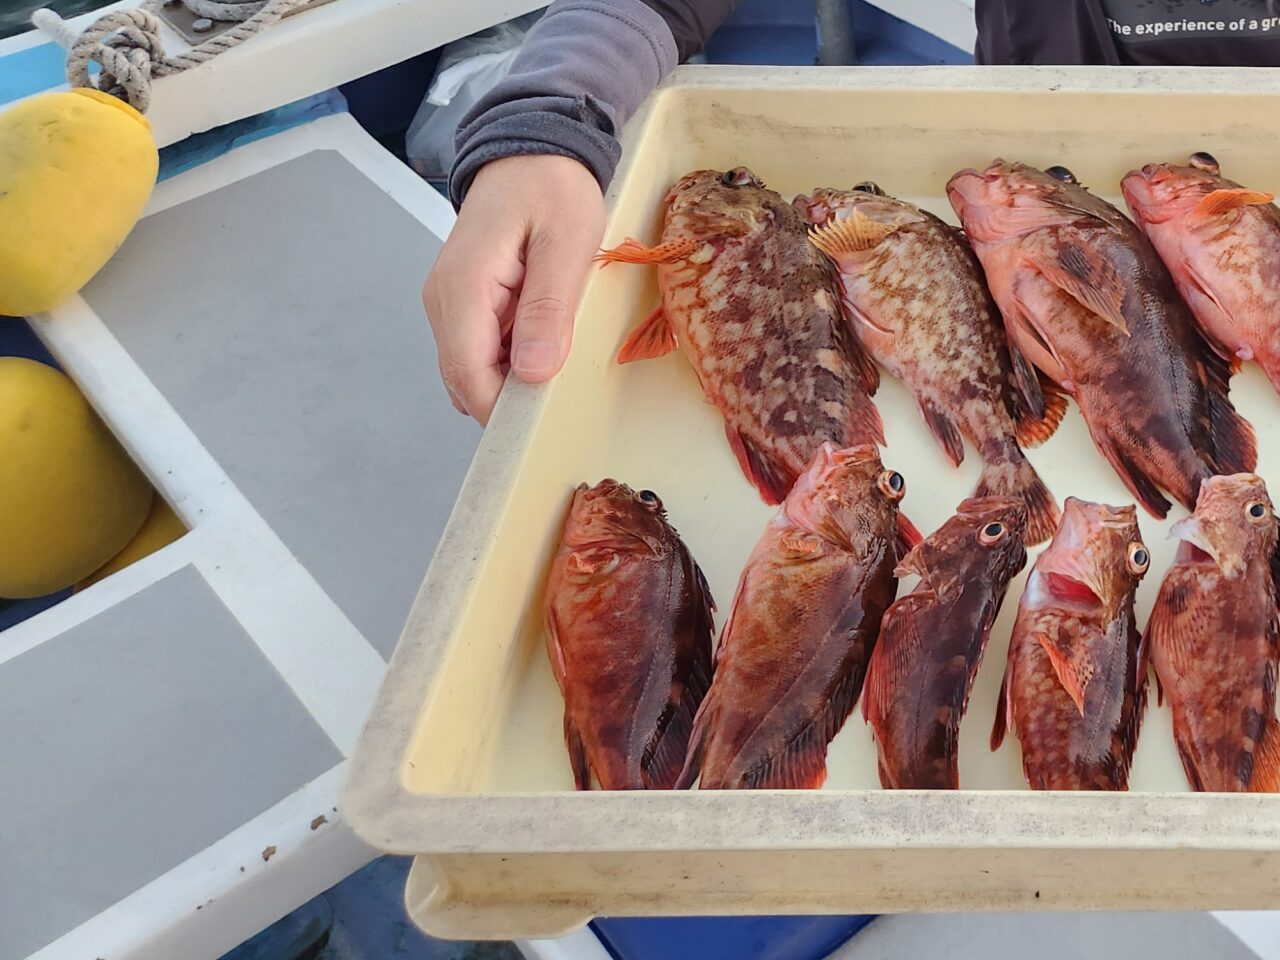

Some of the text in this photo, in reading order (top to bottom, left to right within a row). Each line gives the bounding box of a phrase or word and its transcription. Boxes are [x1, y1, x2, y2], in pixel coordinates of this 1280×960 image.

[1135, 19, 1225, 36] experience
[1229, 18, 1246, 31] of
[1249, 20, 1258, 30] a
